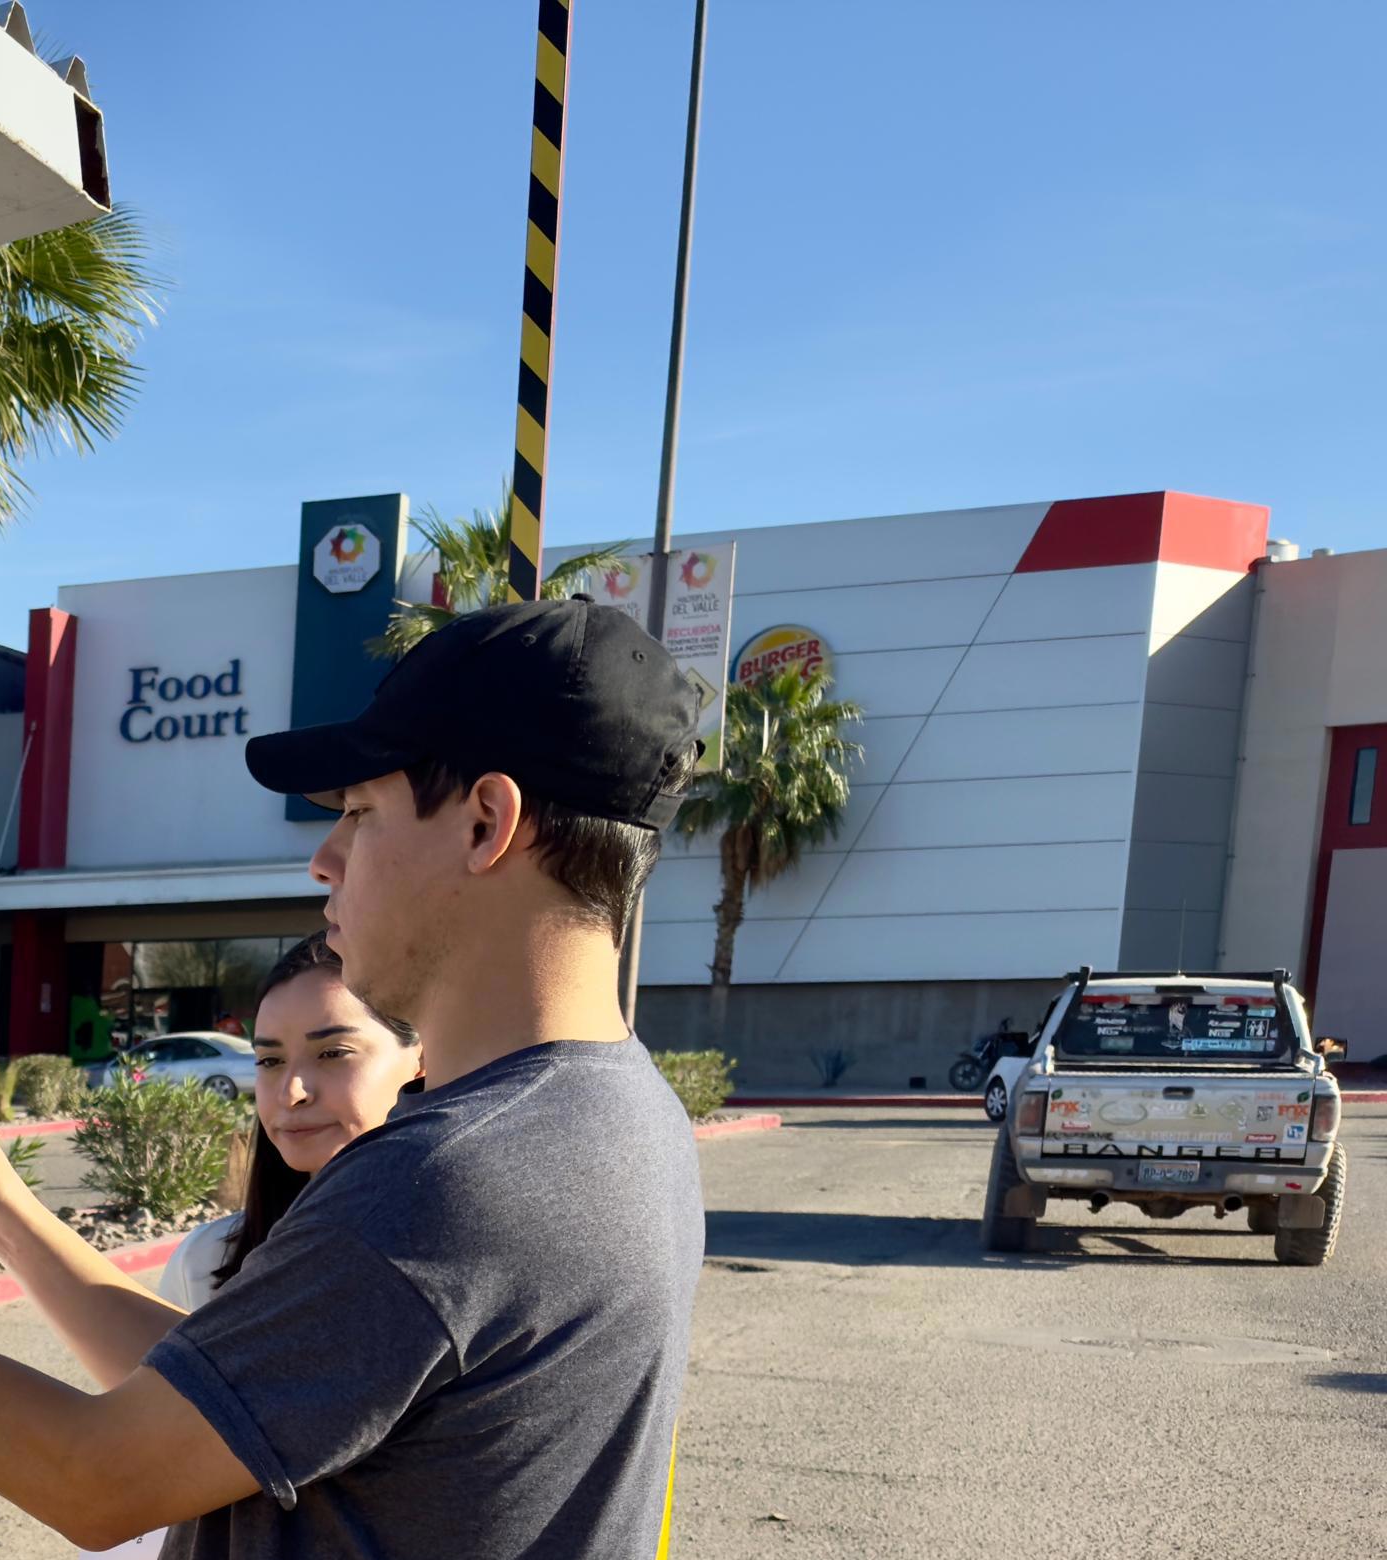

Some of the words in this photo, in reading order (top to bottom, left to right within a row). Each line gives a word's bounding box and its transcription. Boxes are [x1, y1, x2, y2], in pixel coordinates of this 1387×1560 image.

[739, 639, 820, 681] BURGER
[126, 658, 242, 705] Food
[119, 705, 249, 743] Court
[1063, 1143, 1282, 1161] RANGER
